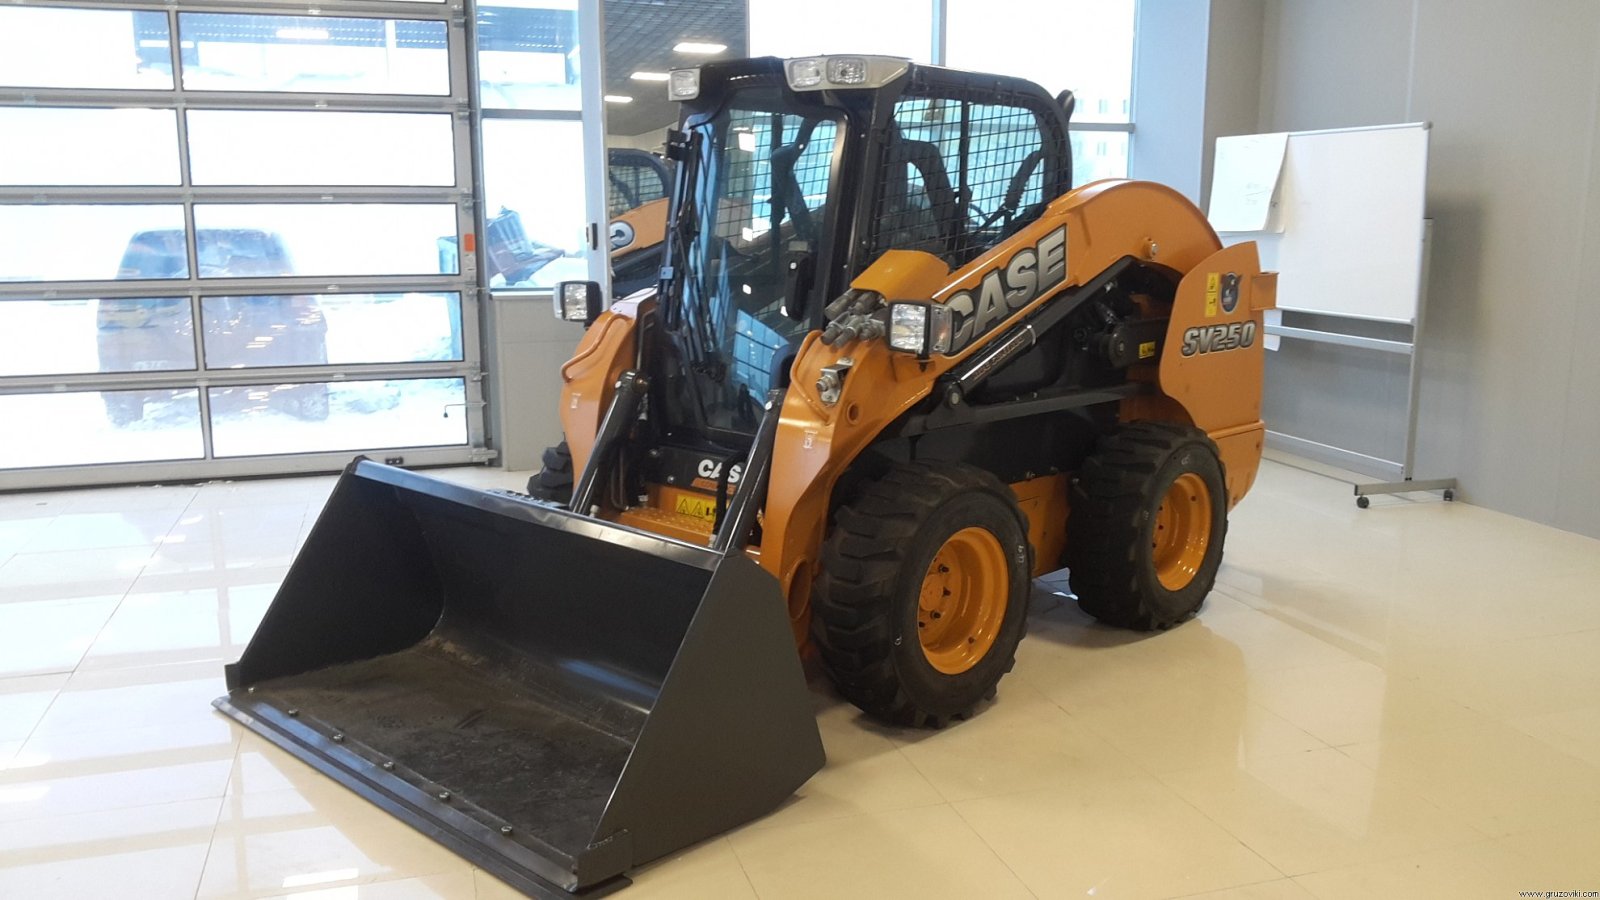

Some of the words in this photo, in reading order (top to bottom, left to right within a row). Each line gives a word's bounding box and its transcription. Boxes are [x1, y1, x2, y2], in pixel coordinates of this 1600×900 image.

[946, 223, 1067, 356] CASE
[1181, 320, 1256, 357] SV250
[697, 459, 742, 484] CAS
